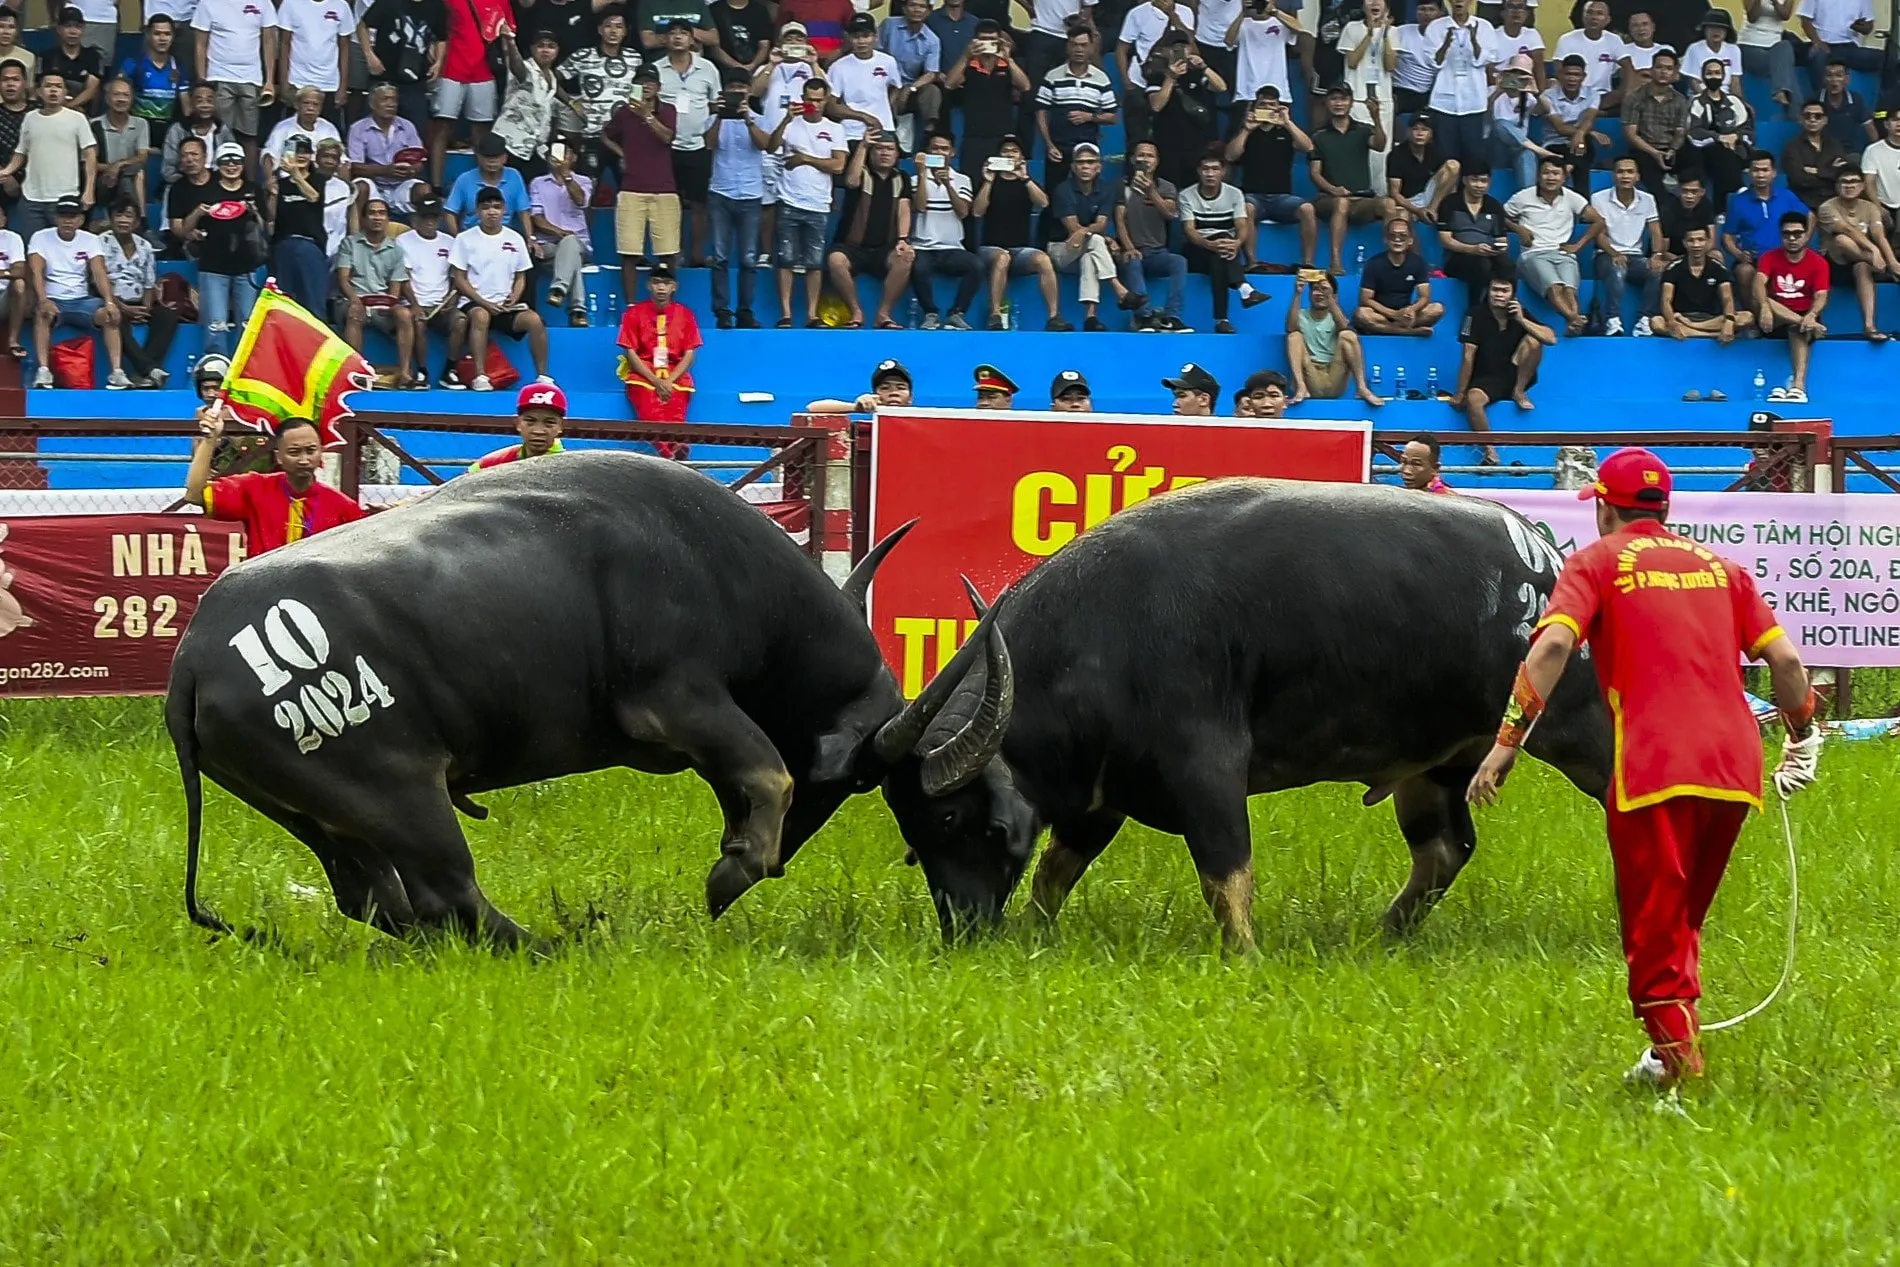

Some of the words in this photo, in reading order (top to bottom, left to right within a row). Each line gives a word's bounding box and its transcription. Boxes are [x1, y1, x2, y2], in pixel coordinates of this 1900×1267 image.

[1012, 445, 1207, 556] CỬ
[112, 523, 208, 577] NHÀ
[1665, 523, 1745, 544] TRUNG
[1753, 519, 1801, 544] TÂM
[1809, 520, 1851, 551] HỘI
[1860, 525, 1900, 546] NG
[1788, 551, 1822, 579] SỐ
[1829, 559, 1880, 582] 20A,
[93, 595, 178, 638] 282
[1785, 587, 1836, 617] KHÊ,
[228, 599, 330, 696] 10
[1802, 626, 1900, 646] HOTLINE
[274, 655, 395, 754] 2024
